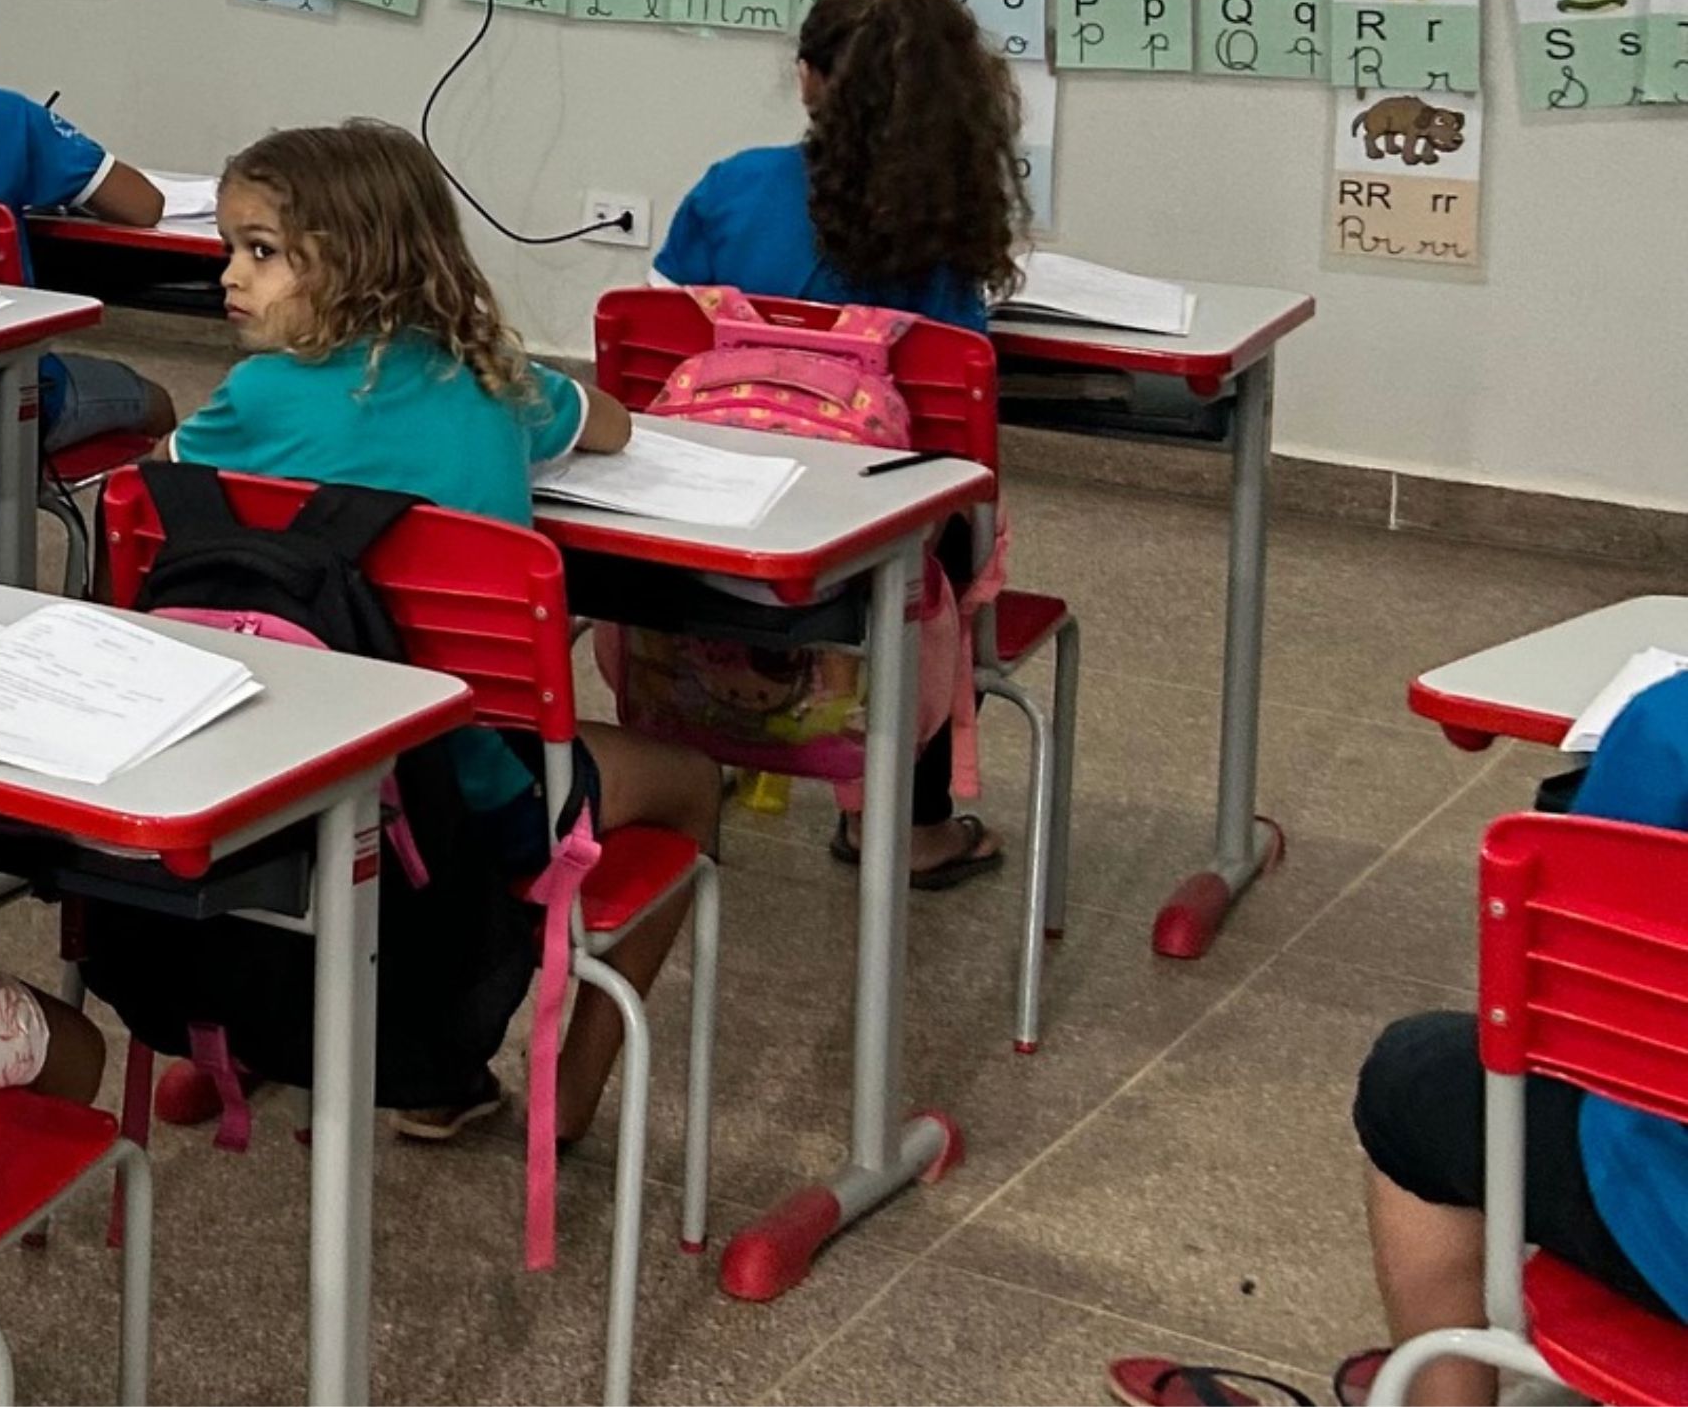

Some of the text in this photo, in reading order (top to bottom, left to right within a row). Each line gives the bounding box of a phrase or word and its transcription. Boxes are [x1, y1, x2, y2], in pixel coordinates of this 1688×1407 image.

[1294, 0, 1315, 30] q
[1356, 10, 1442, 42] R r
[1339, 180, 1458, 214] RR rr
